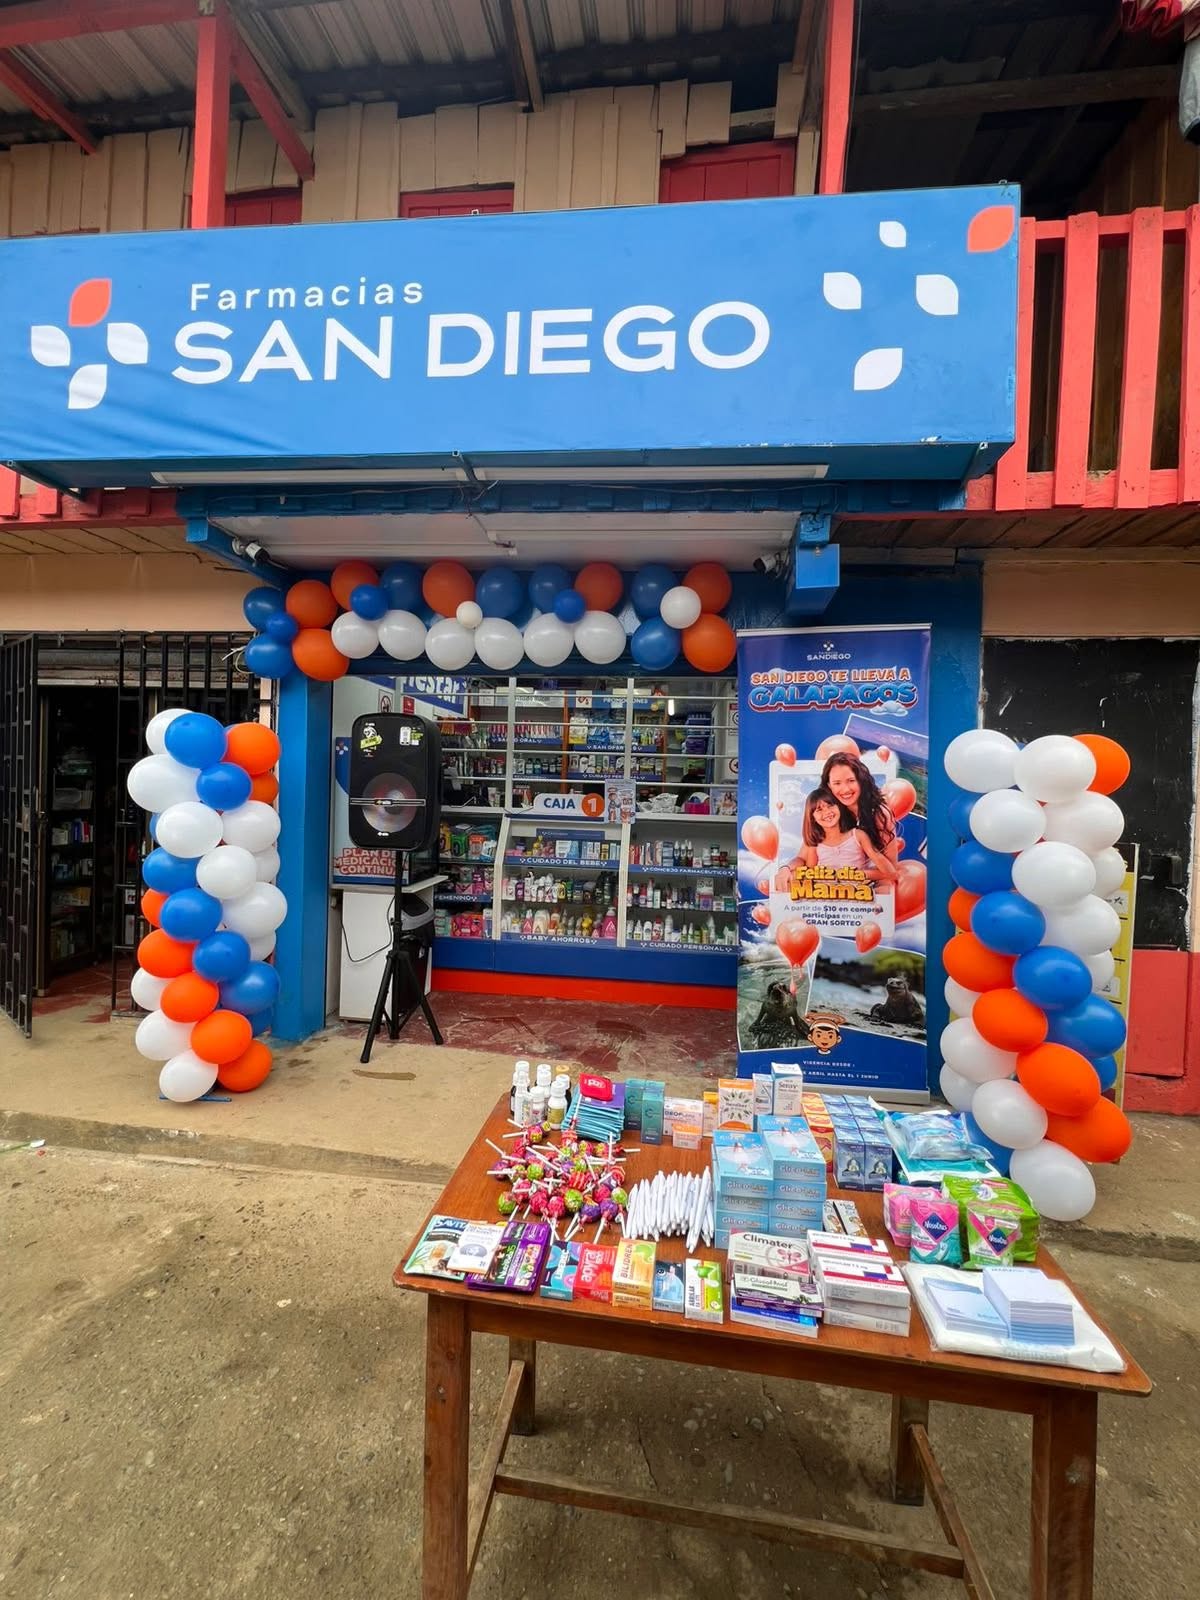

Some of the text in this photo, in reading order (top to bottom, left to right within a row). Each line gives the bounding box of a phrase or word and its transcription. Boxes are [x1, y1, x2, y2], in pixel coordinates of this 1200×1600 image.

[191, 277, 423, 311] Farmacias
[172, 301, 770, 384] SAN DIEGO
[751, 667, 910, 685] SAN DIEGO TE LLEVA A
[750, 682, 918, 712] GALAPAGOS
[543, 798, 597, 813] CAJA 1
[343, 849, 379, 857] PLAN
[526, 858, 561, 866] CUIDADO
[340, 865, 396, 876] CONTINU
[796, 866, 866, 881] Feliz día
[791, 879, 874, 901] Mamá
[791, 905, 811, 913] partir
[683, 944, 725, 952] PERSONAL
[743, 1233, 793, 1250] Climater
[620, 1243, 633, 1279] BILIDREN
